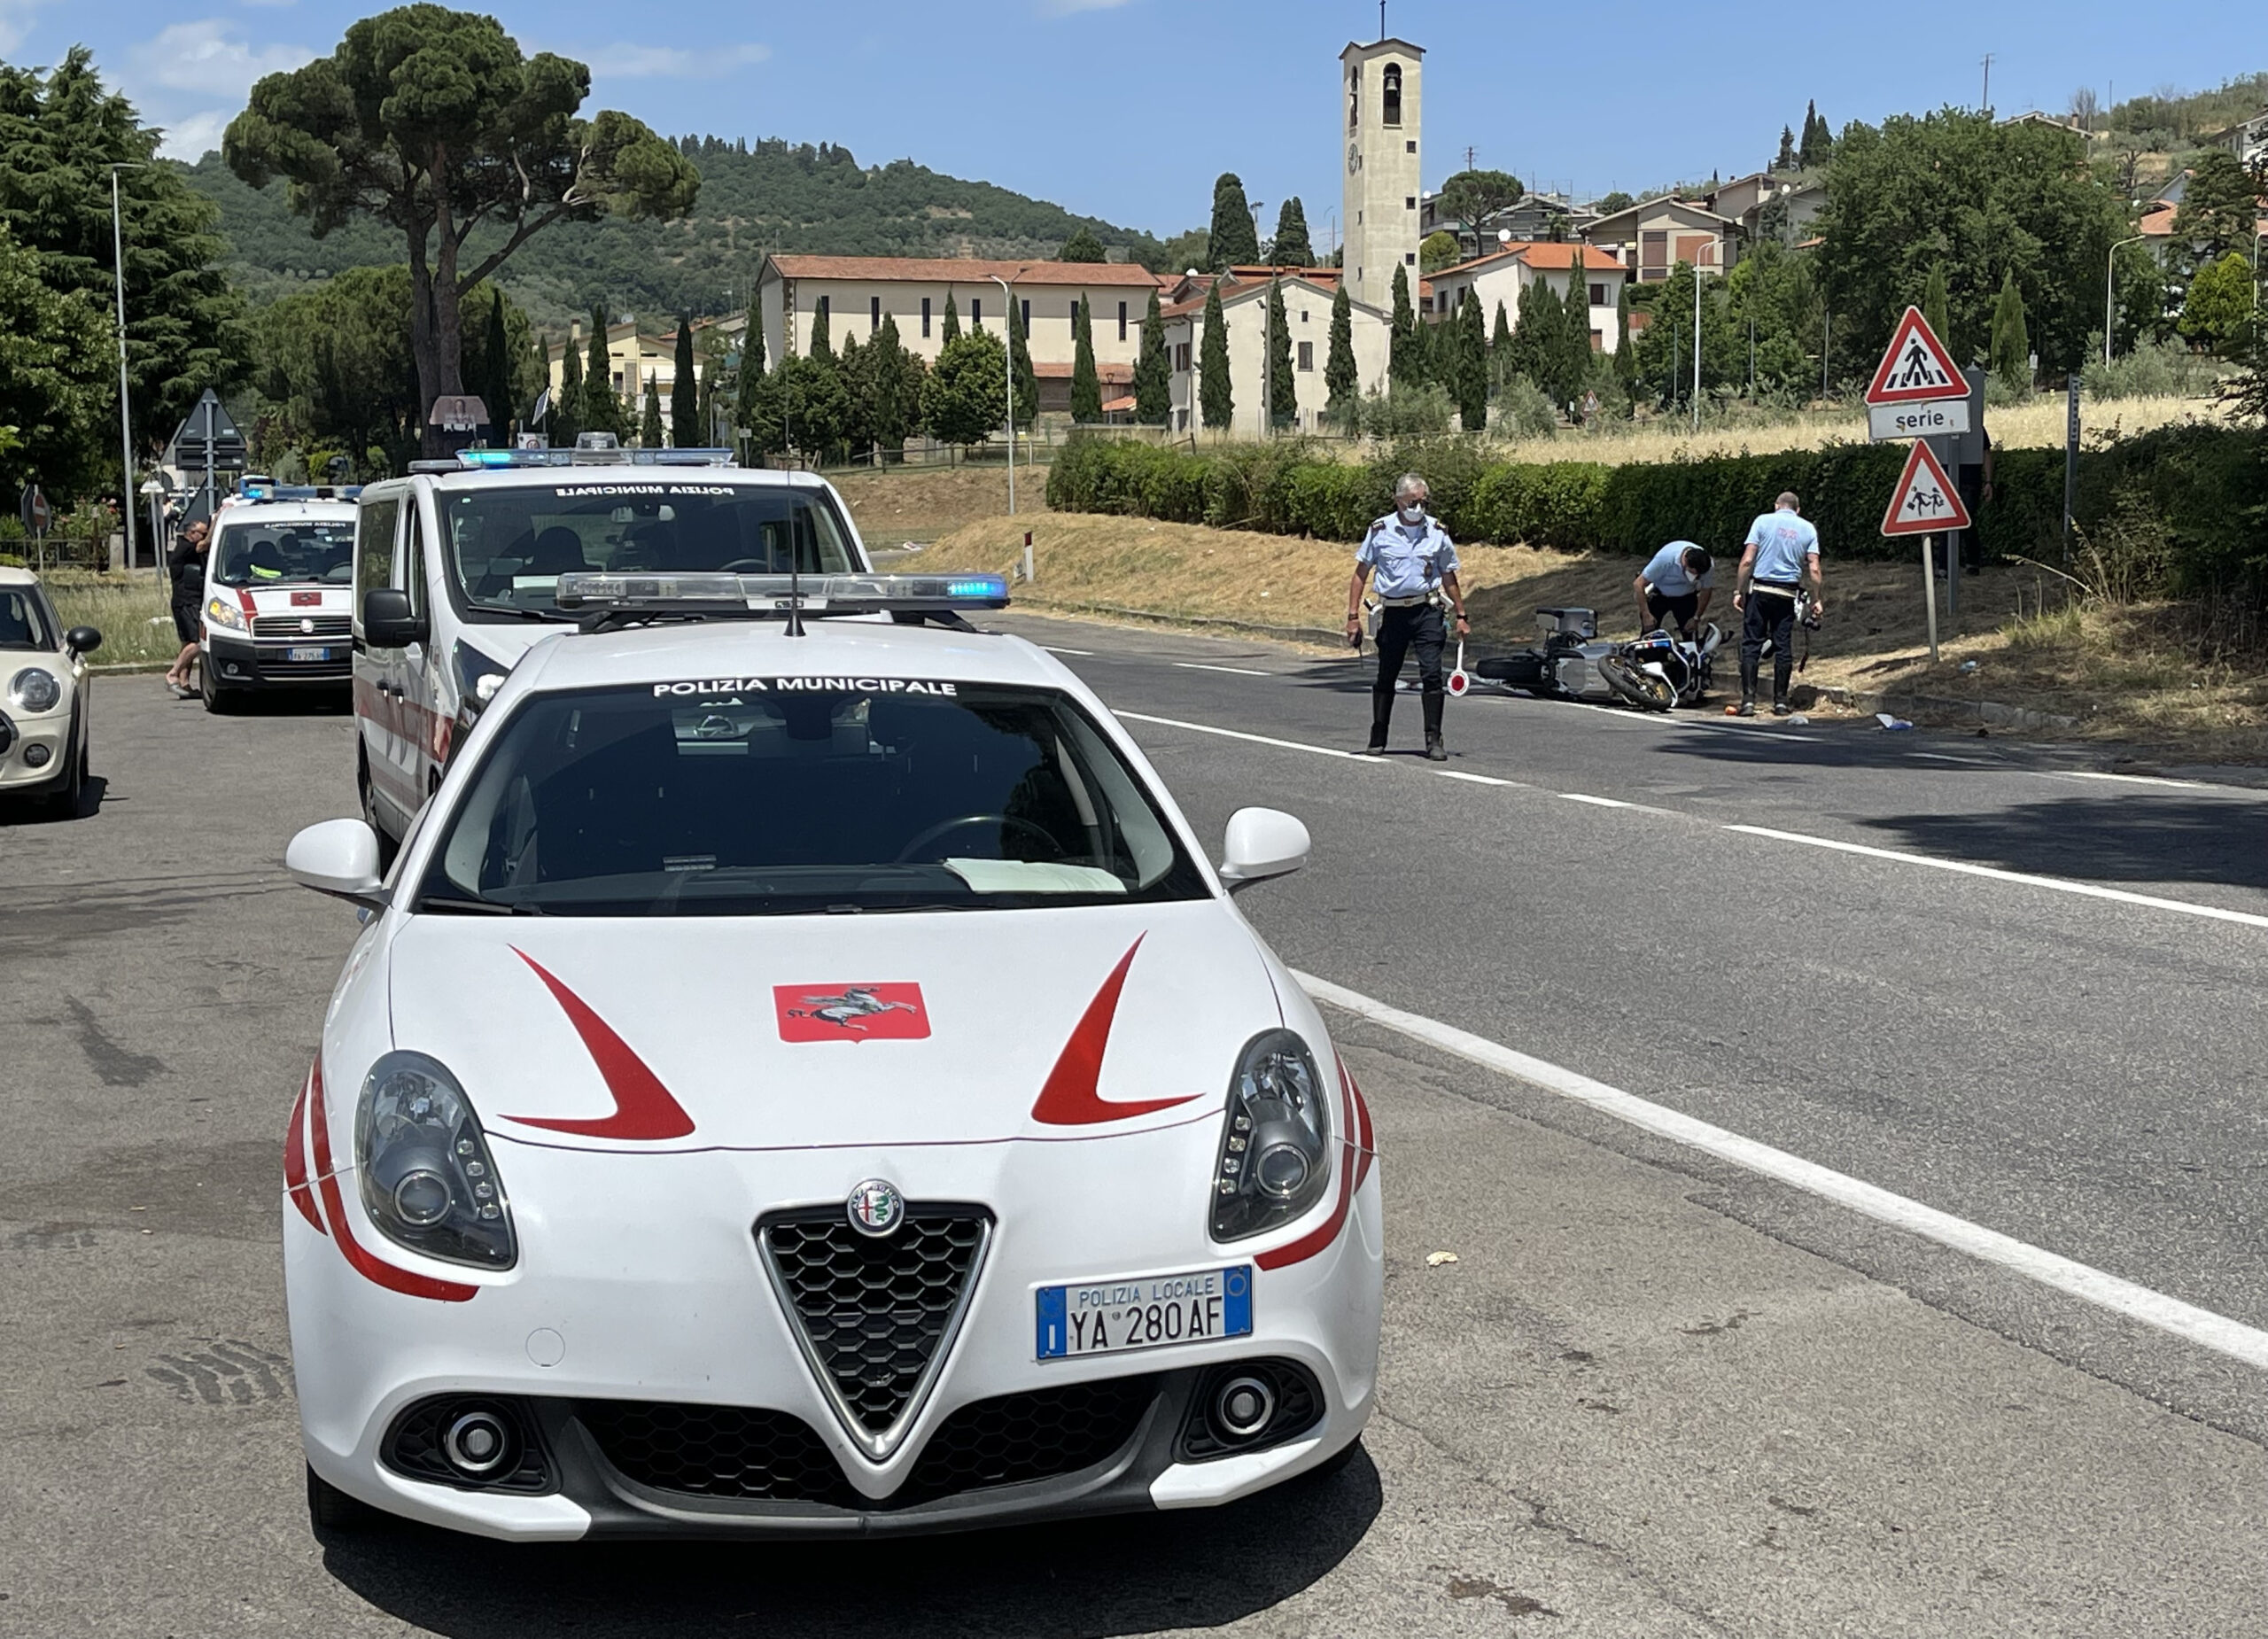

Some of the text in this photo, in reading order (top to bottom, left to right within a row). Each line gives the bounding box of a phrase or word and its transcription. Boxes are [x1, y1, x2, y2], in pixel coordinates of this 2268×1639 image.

[1896, 409, 1944, 429] serie
[653, 678, 958, 697] POLIZIA MUNICIPALE
[1079, 1276, 1215, 1308] POLIZIA LOCALE
[1070, 1309, 1108, 1350] YA
